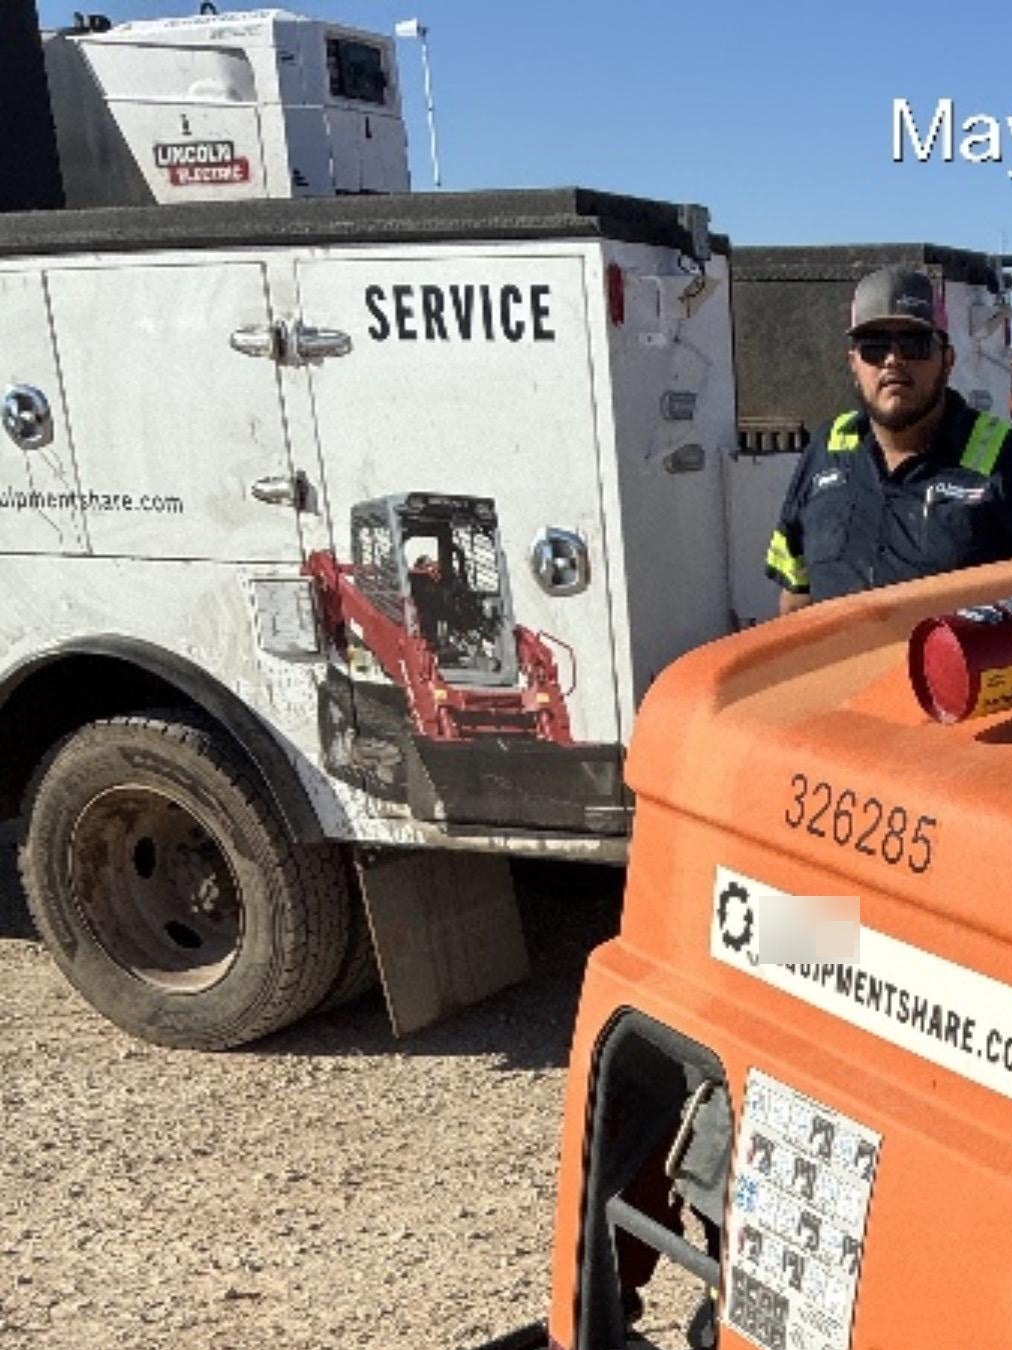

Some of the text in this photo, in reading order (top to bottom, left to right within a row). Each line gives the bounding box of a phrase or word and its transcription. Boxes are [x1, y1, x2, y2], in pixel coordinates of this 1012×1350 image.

[158, 143, 232, 165] LINCOLN
[365, 284, 556, 342] SERVICE
[785, 773, 937, 873] 326285
